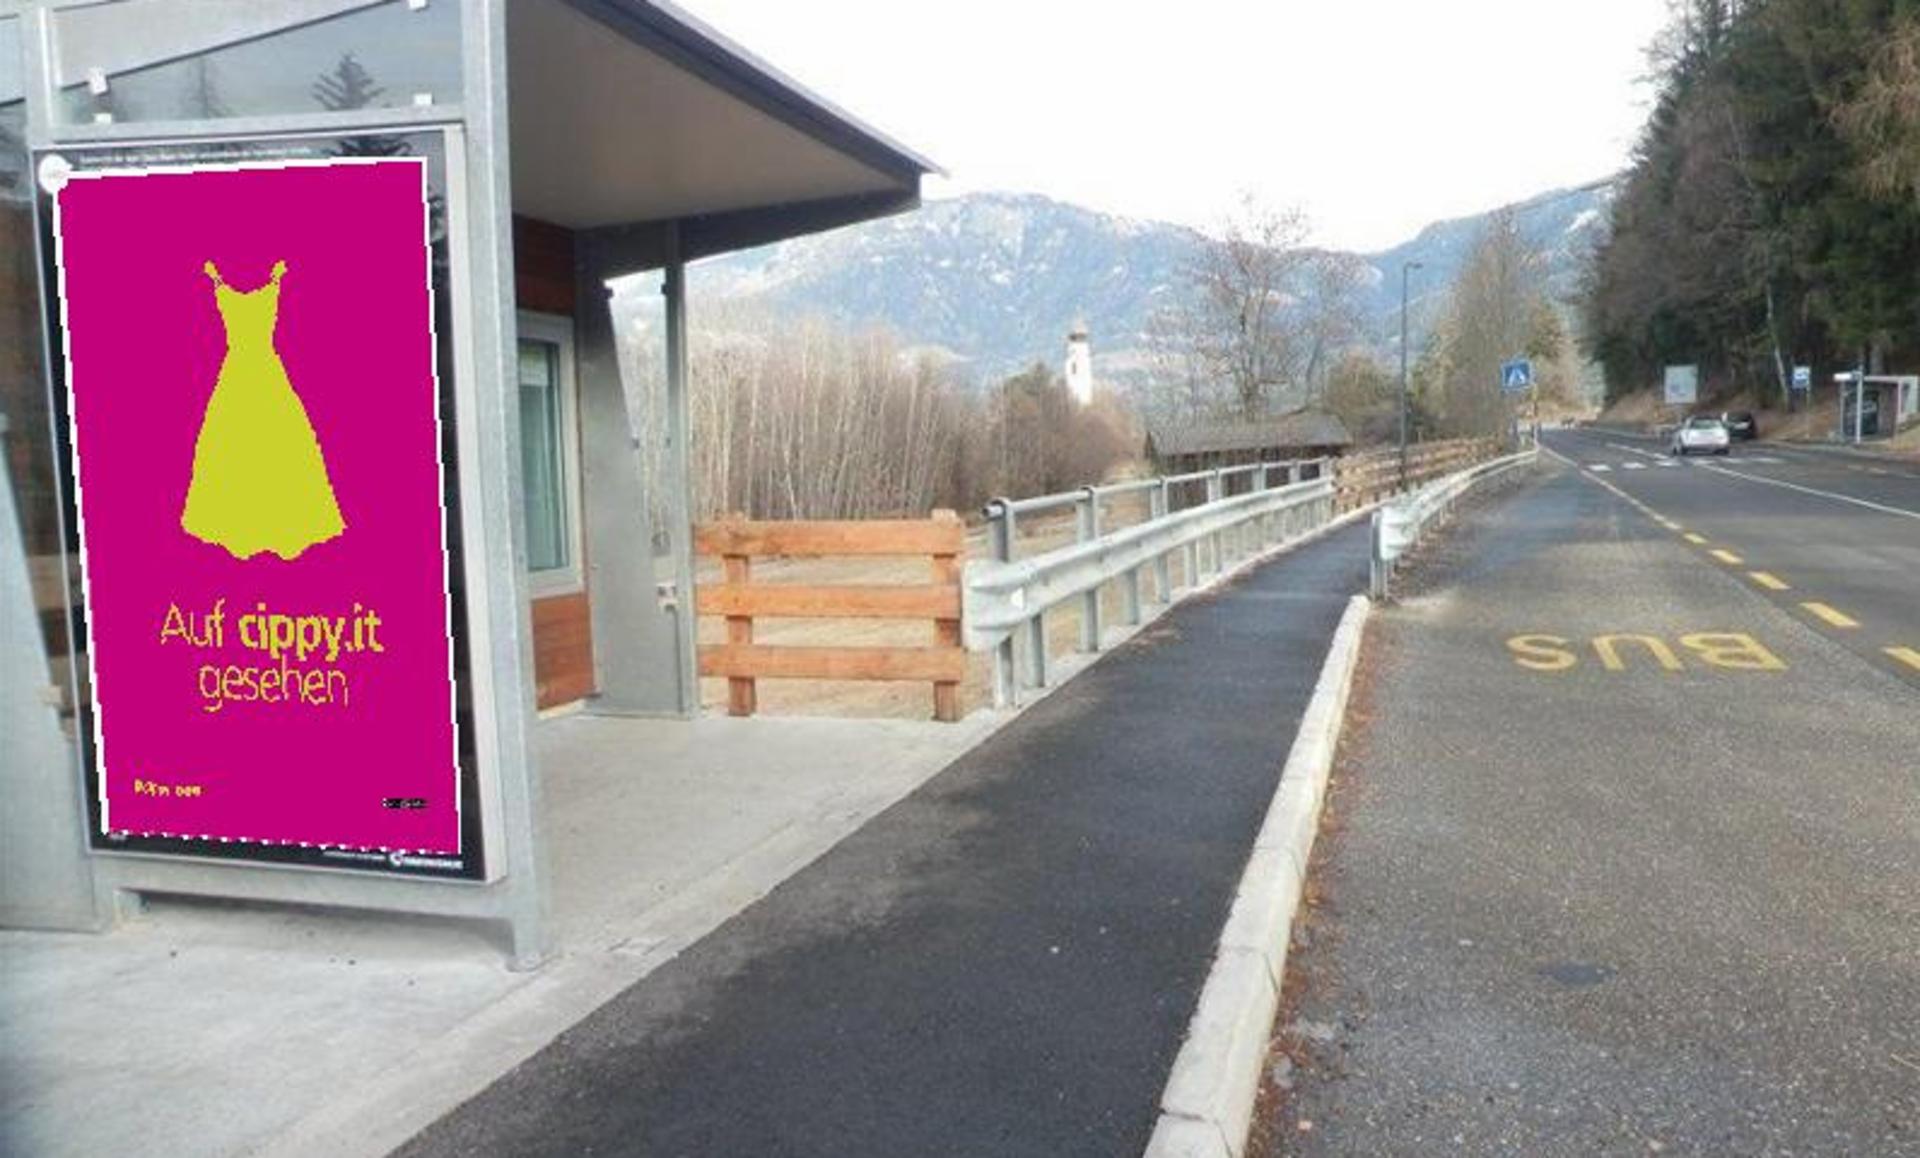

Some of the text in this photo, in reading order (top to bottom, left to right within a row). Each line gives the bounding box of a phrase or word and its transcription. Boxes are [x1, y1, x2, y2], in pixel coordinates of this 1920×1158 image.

[160, 598, 384, 662] Auf cippy.it
[1506, 632, 1790, 671] BUS
[199, 654, 349, 712] gesehen
